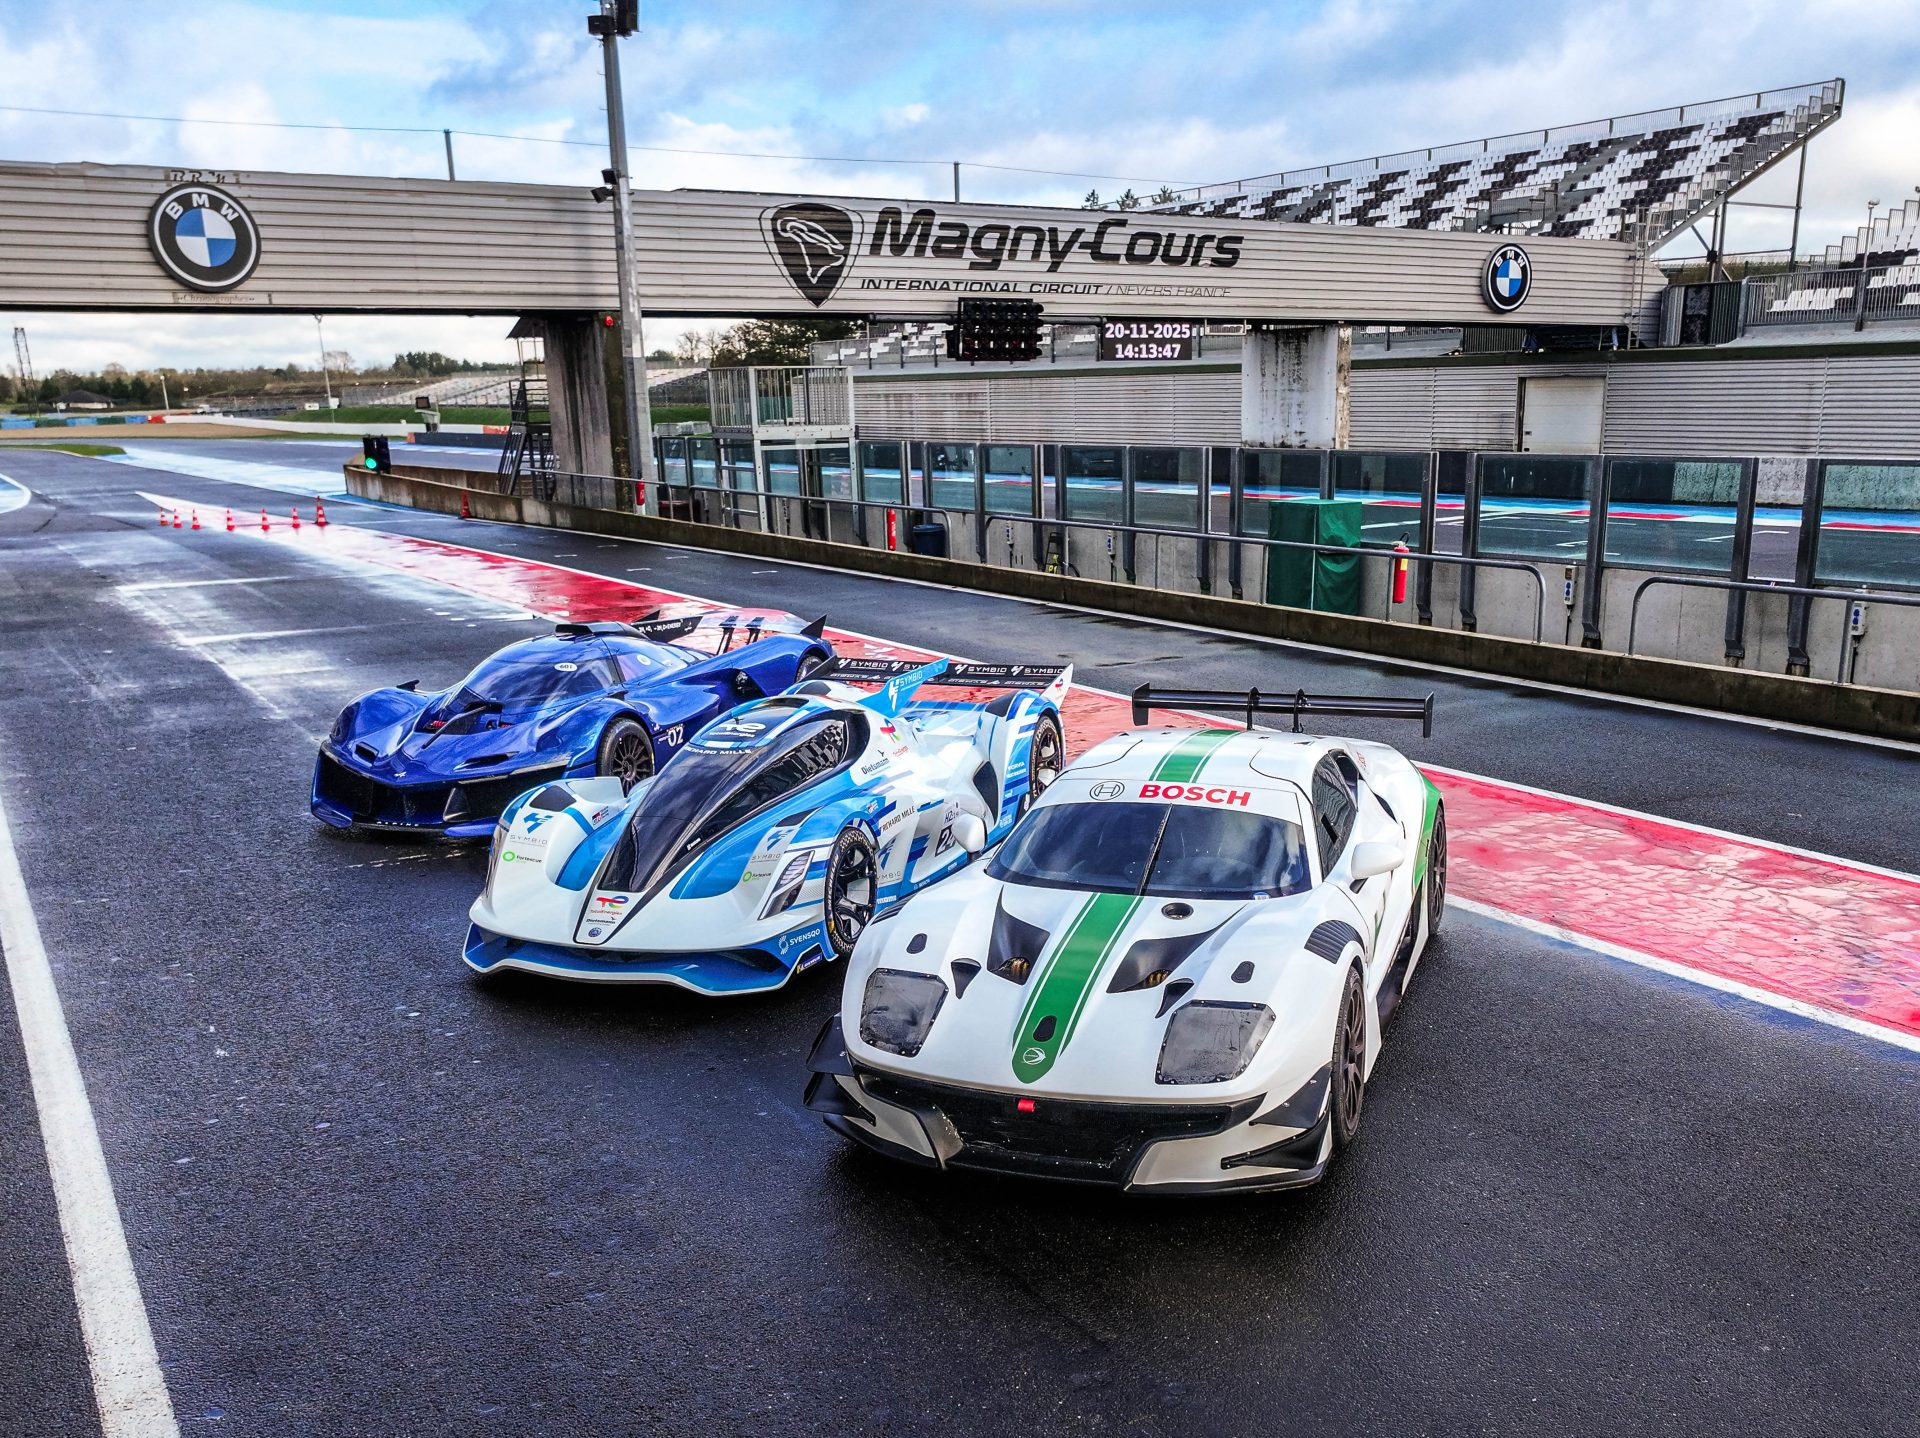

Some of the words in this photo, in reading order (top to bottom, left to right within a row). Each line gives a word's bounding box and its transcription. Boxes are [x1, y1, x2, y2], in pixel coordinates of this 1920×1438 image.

[165, 193, 239, 221] BMW
[869, 206, 1244, 272] Magny-Cours
[1495, 250, 1526, 268] BMW
[861, 279, 1022, 294] INTERNATIONAL
[1030, 283, 1104, 295] CIRCUIT
[1117, 284, 1172, 297] NEVERS
[1176, 286, 1231, 298] FRANCE
[1105, 322, 1191, 339] 20-11-2025
[1115, 343, 1181, 359] 14:13:47
[849, 660, 888, 668] SYMBIO
[967, 666, 1007, 674] SYMBIO
[899, 671, 923, 687] SYMBIO
[668, 726, 684, 747] 02
[861, 757, 890, 775] Dietsmann
[1139, 784, 1251, 807] BOSCH
[882, 814, 902, 832] RICHARD
[902, 806, 916, 819] MILLE
[510, 834, 548, 845] SYMBIO
[752, 853, 781, 861] SYMBIO
[789, 928, 821, 946] SYENSQO
